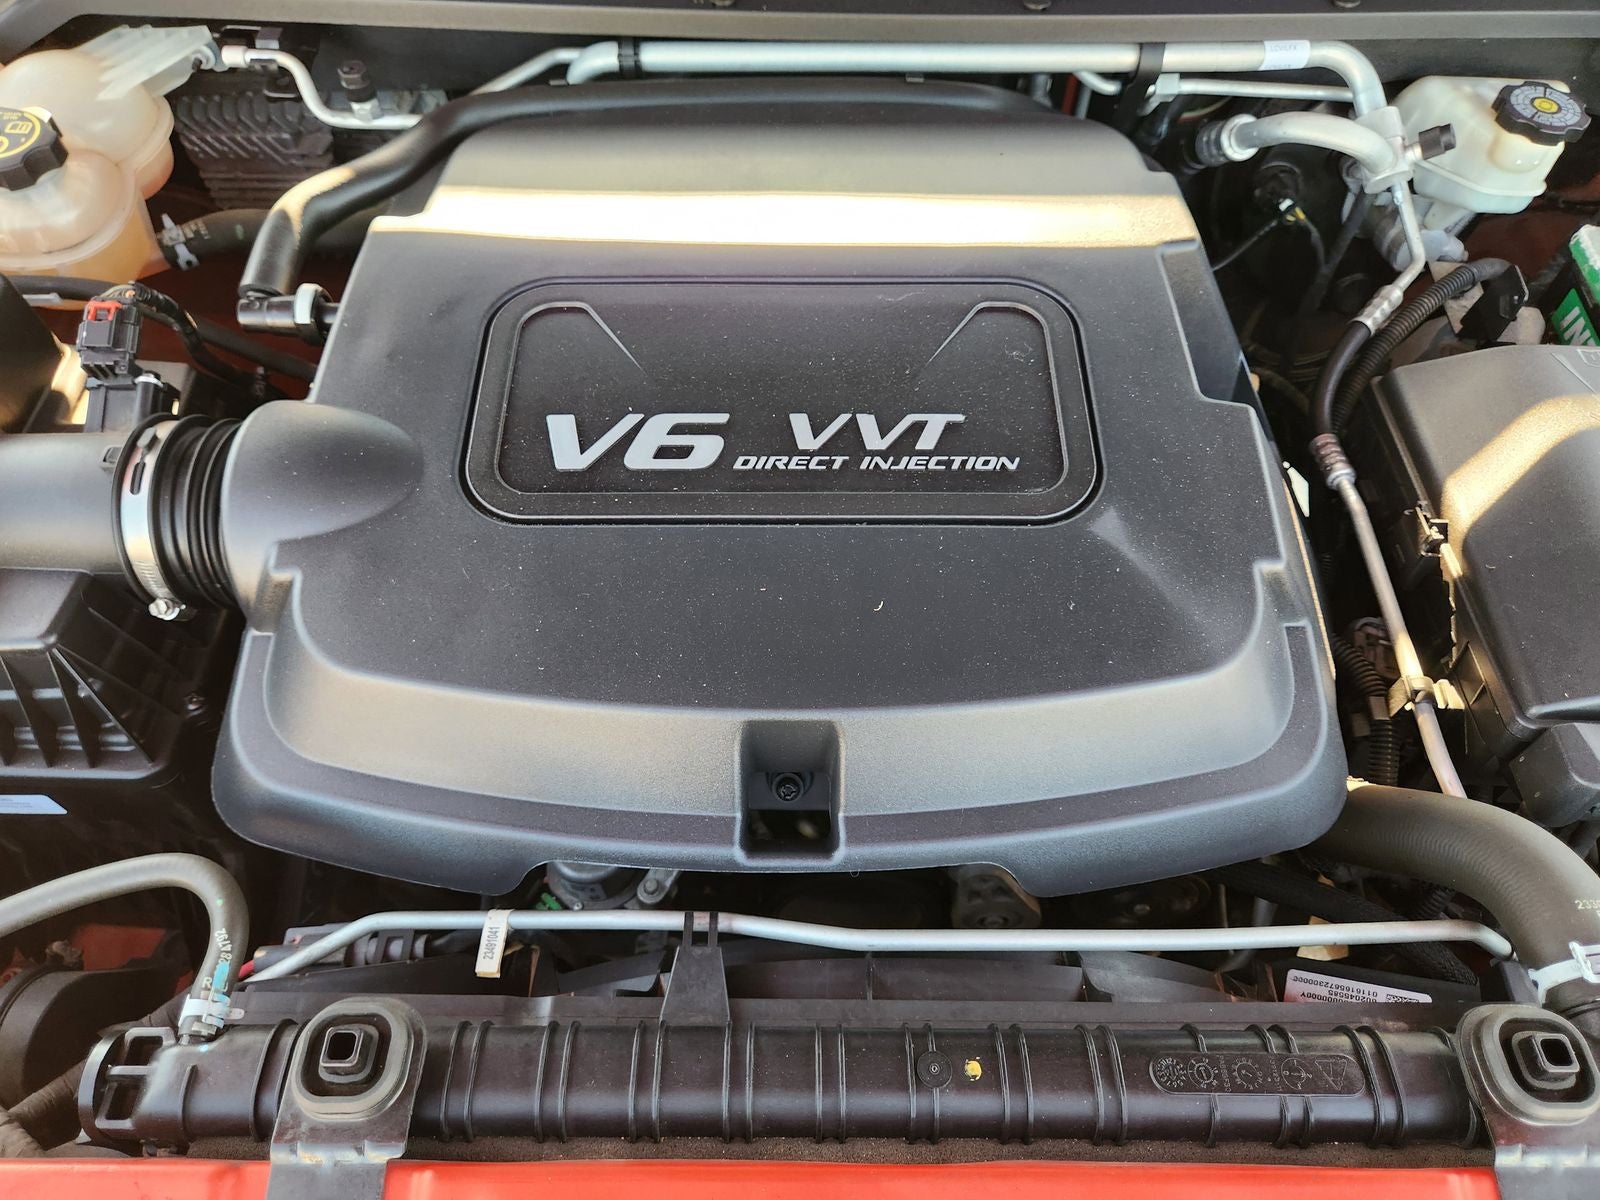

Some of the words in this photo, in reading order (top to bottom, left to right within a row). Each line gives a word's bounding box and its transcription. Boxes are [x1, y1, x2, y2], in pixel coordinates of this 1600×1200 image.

[545, 413, 730, 470] V6
[789, 413, 966, 450] VVT
[732, 456, 848, 470] DIRECT
[859, 456, 1019, 470] INJECTION
[482, 926, 500, 960] 23491041
